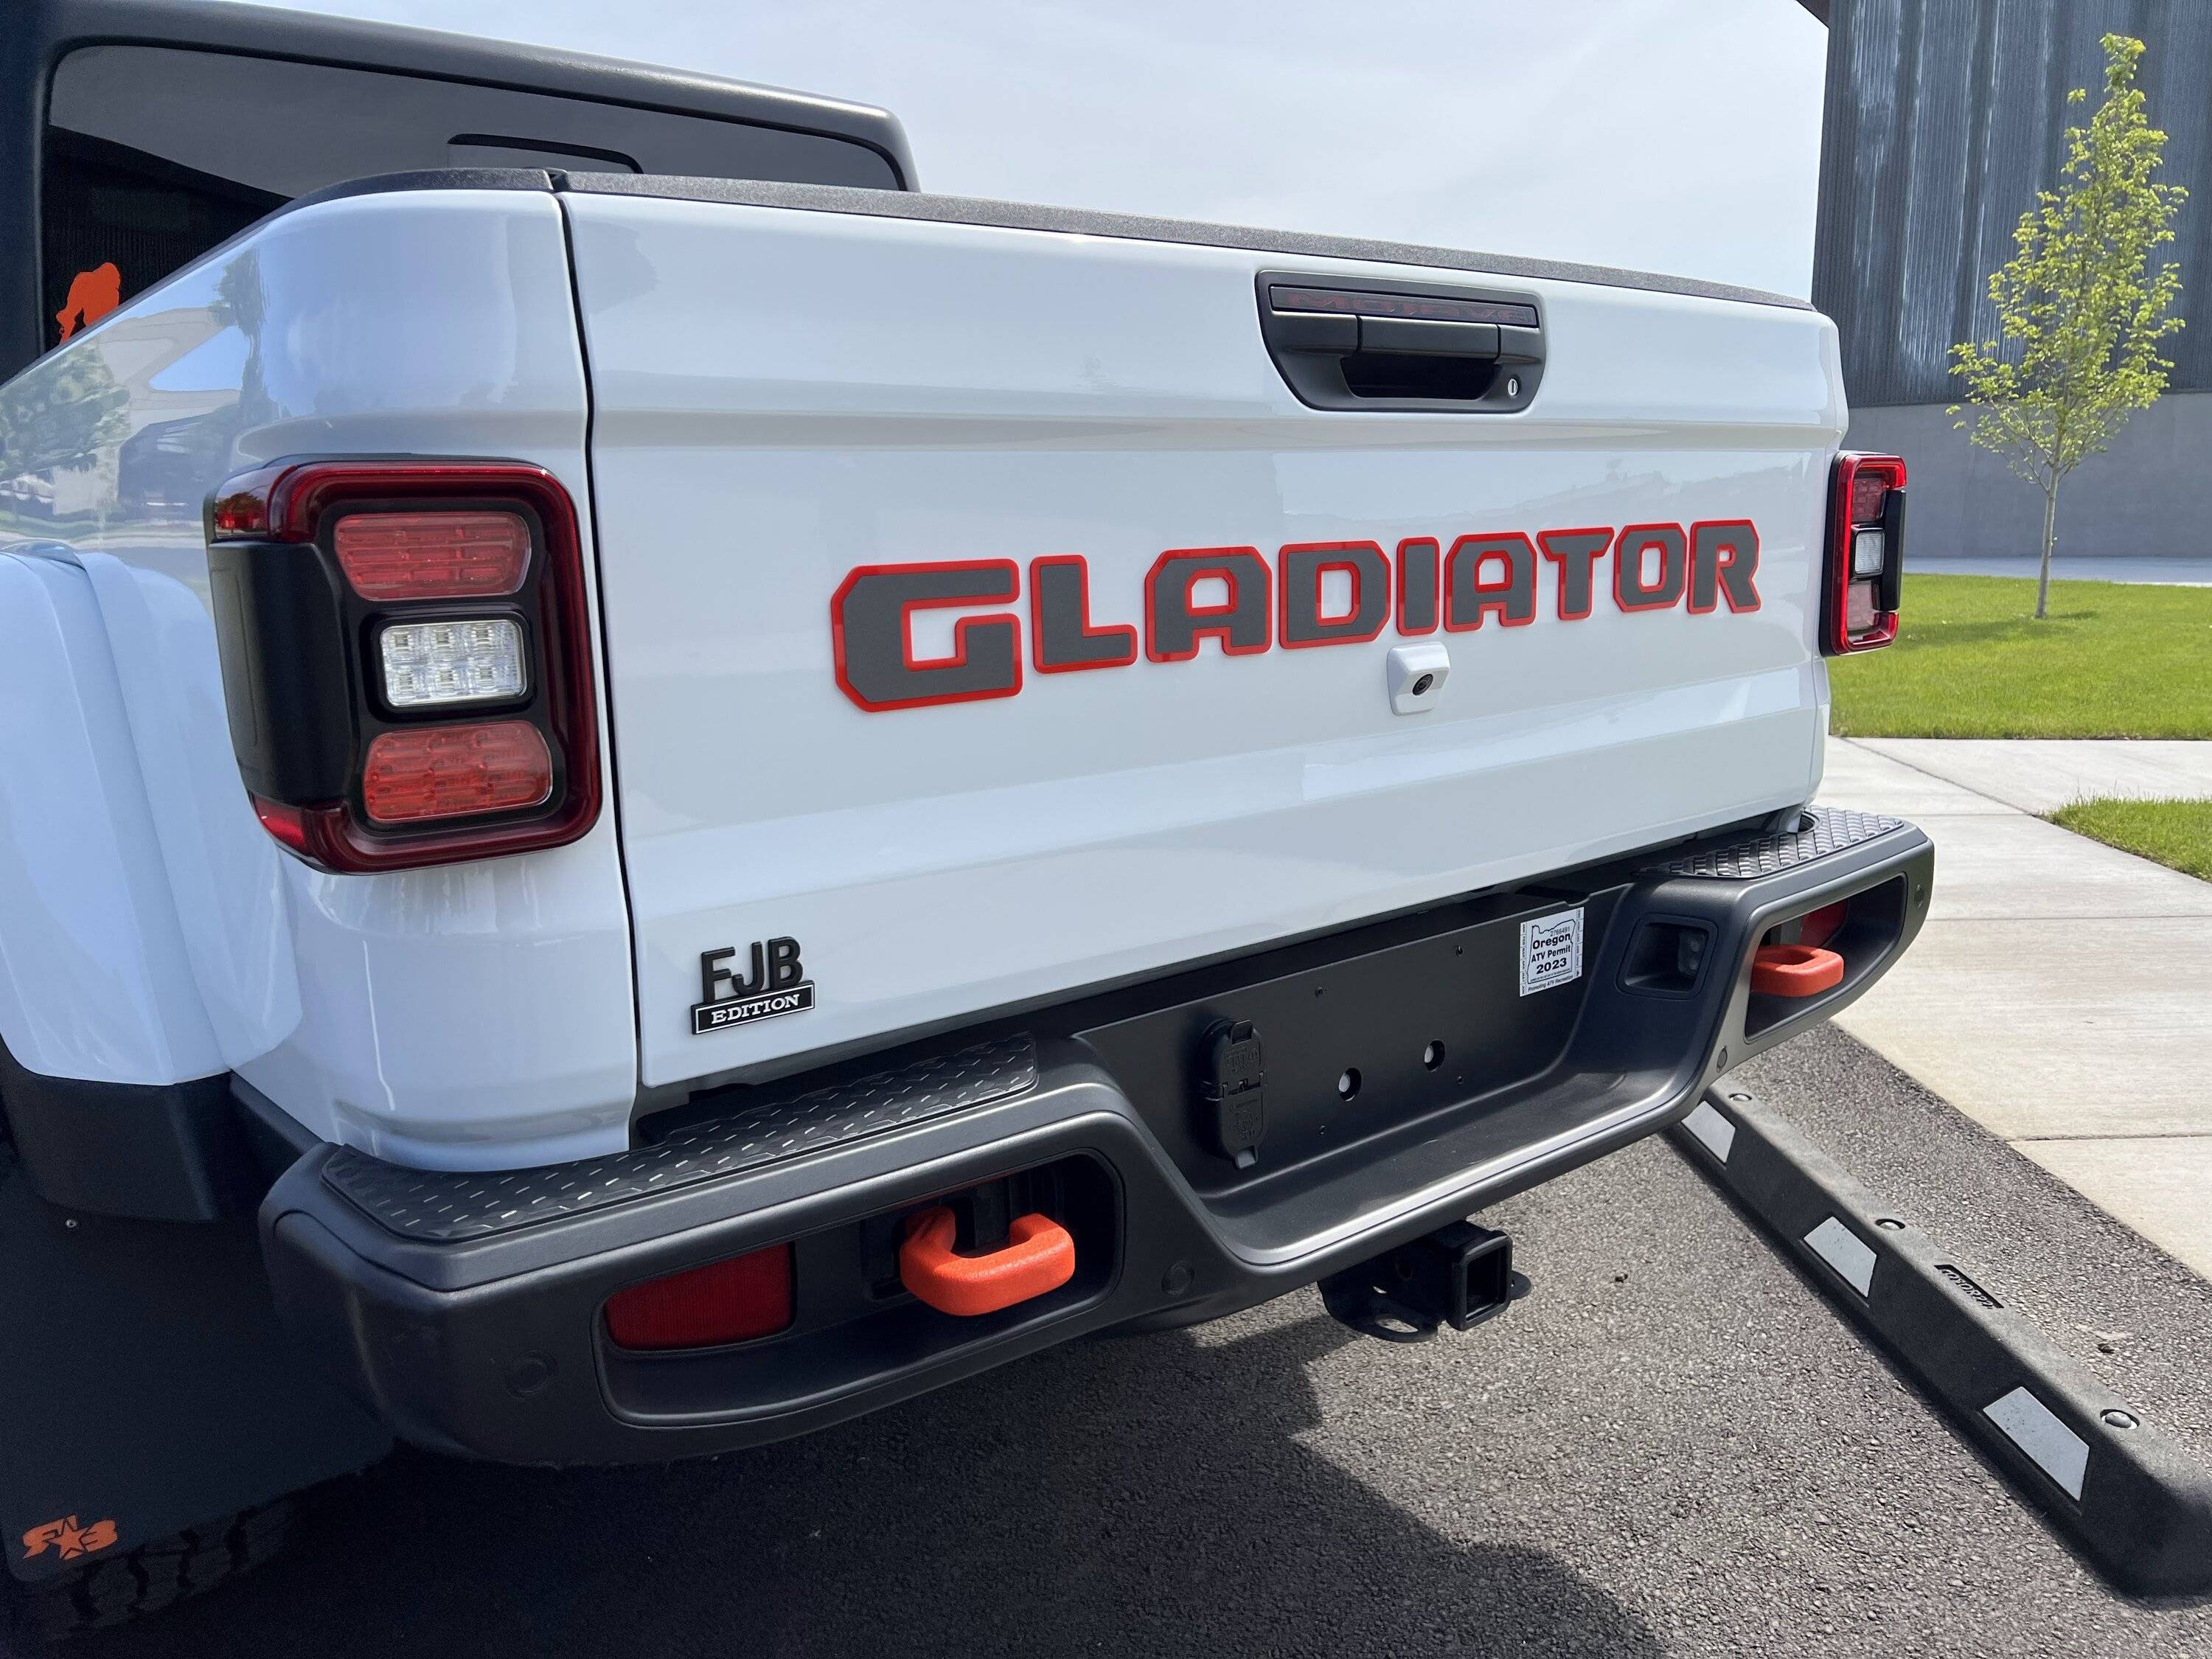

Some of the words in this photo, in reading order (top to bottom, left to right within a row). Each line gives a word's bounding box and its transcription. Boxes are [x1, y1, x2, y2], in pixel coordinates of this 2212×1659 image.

[830, 518, 1762, 713] GLADIATOR
[1532, 933, 1571, 950] Oregon
[1531, 952, 1545, 962] ATV
[1548, 945, 1571, 958] Permit
[701, 936, 803, 1004] FJB
[1537, 958, 1567, 974] 2023
[711, 993, 801, 1023] EDITION
